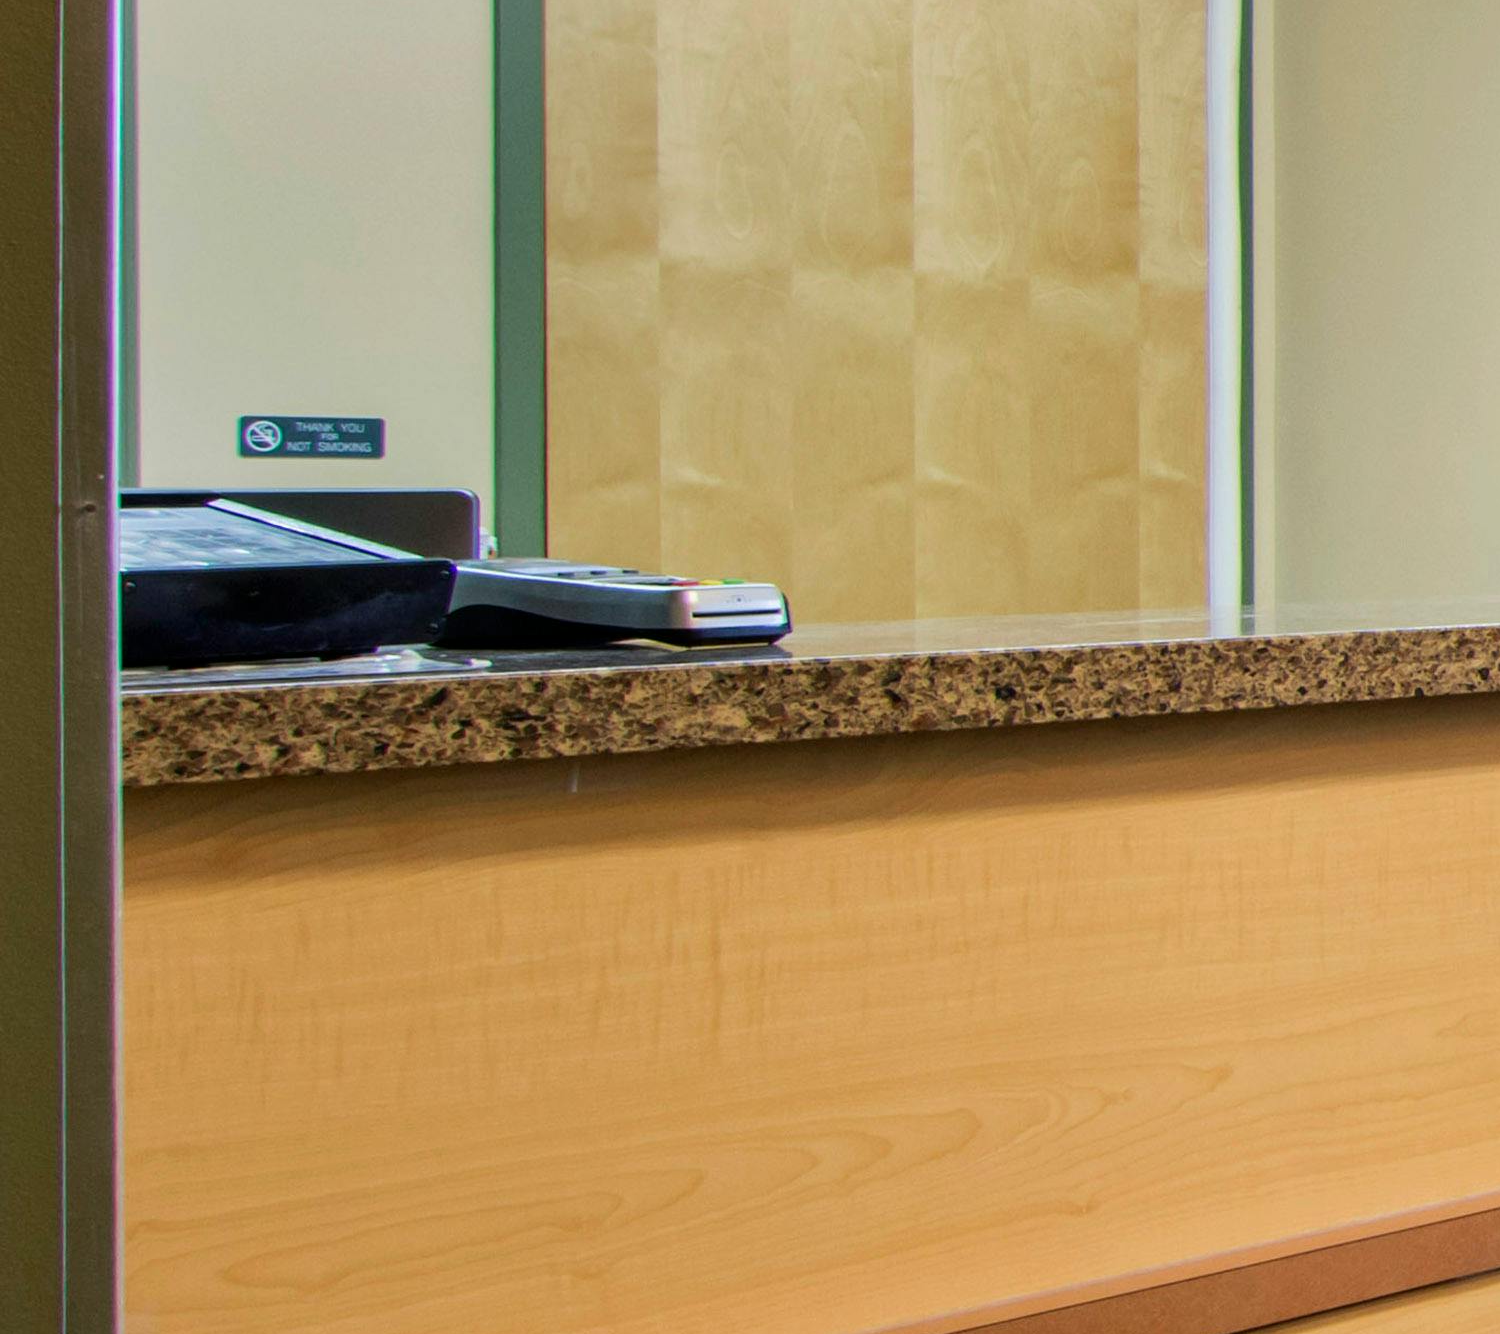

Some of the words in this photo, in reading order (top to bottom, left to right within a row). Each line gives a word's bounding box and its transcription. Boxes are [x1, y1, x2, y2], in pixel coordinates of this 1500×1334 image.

[295, 421, 335, 433] THANK
[340, 422, 366, 434] YOU
[320, 433, 340, 441] FOR
[286, 441, 312, 452] NOT
[318, 442, 372, 453] SMOKING
